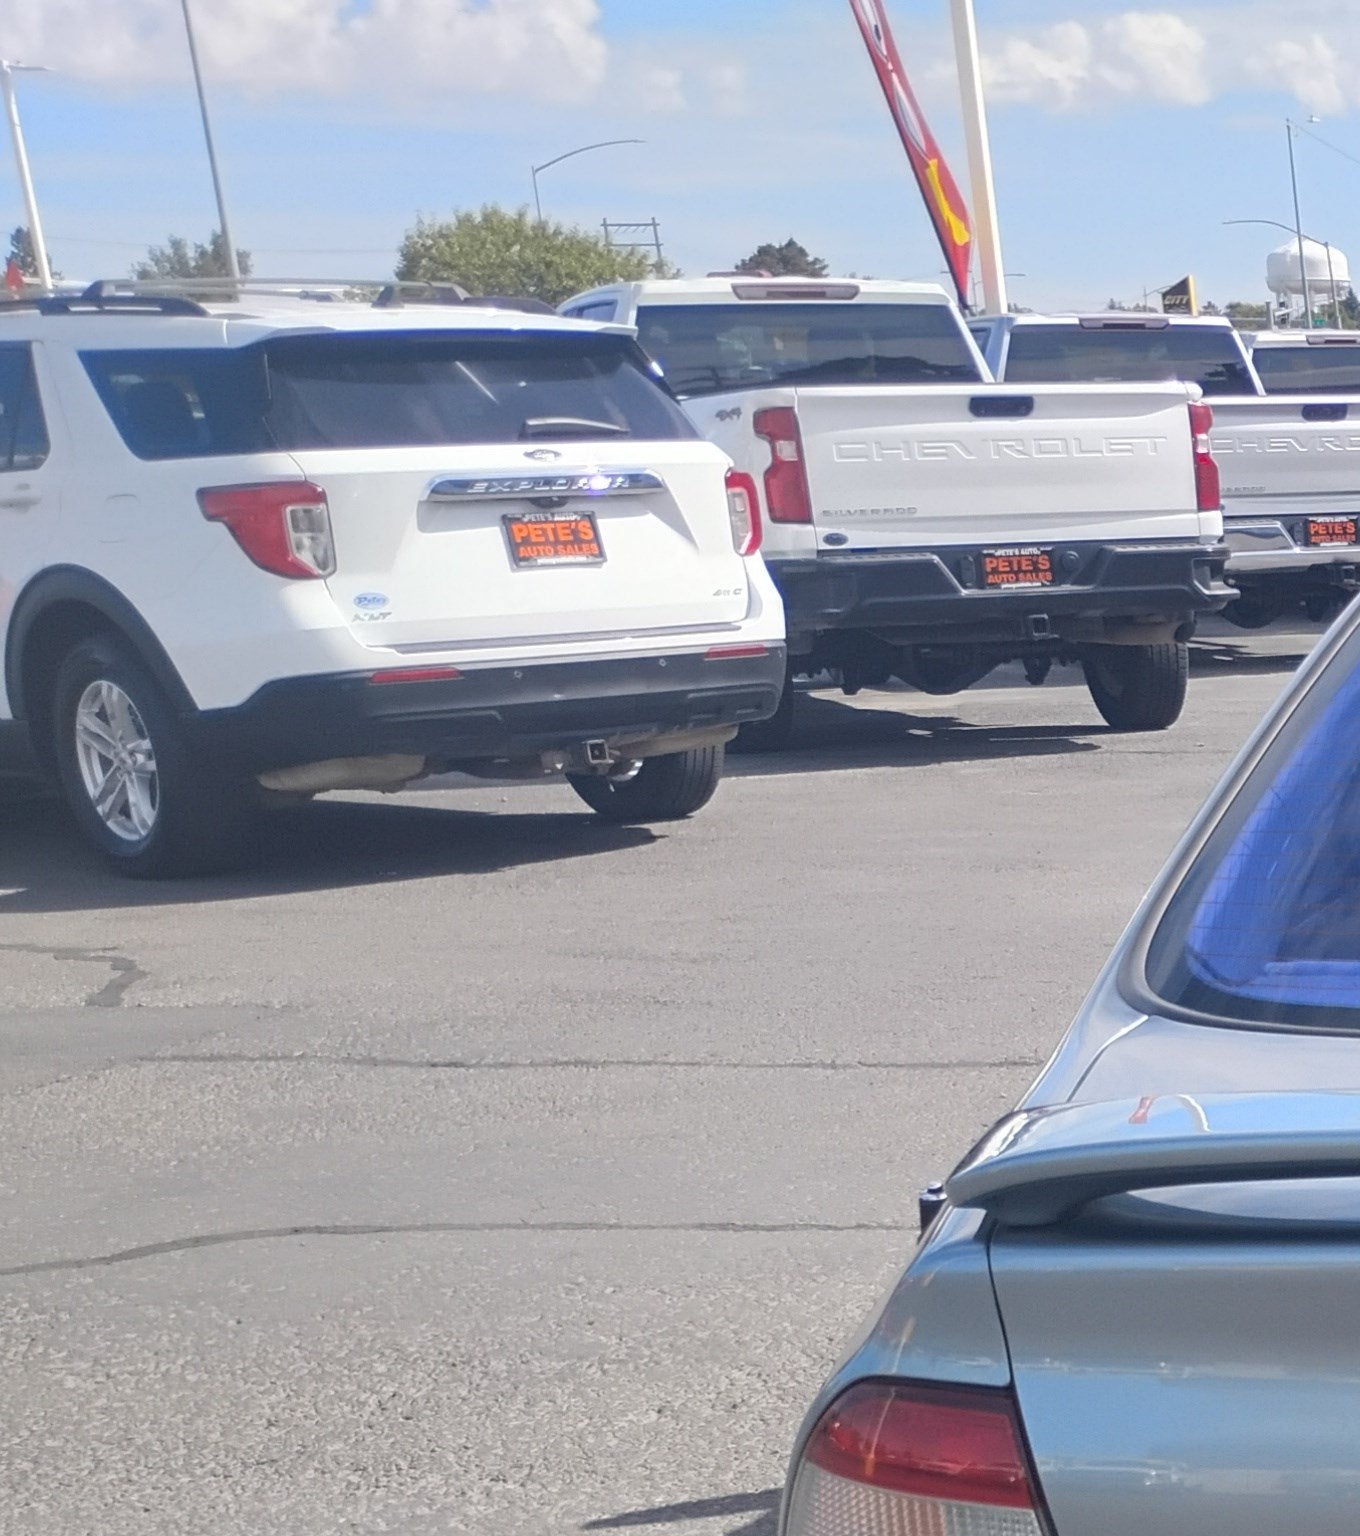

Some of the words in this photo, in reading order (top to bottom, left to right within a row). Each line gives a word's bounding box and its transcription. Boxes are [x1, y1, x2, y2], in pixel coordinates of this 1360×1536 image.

[833, 436, 1167, 462] CHEVROLET
[511, 521, 594, 543] PETE'S
[1310, 521, 1355, 534] PETE'S
[518, 545, 554, 557] AUTO
[557, 544, 599, 556] SALES
[985, 555, 1050, 572] PETE'S
[987, 573, 1016, 584] AUTO
[1018, 571, 1053, 582] SALES
